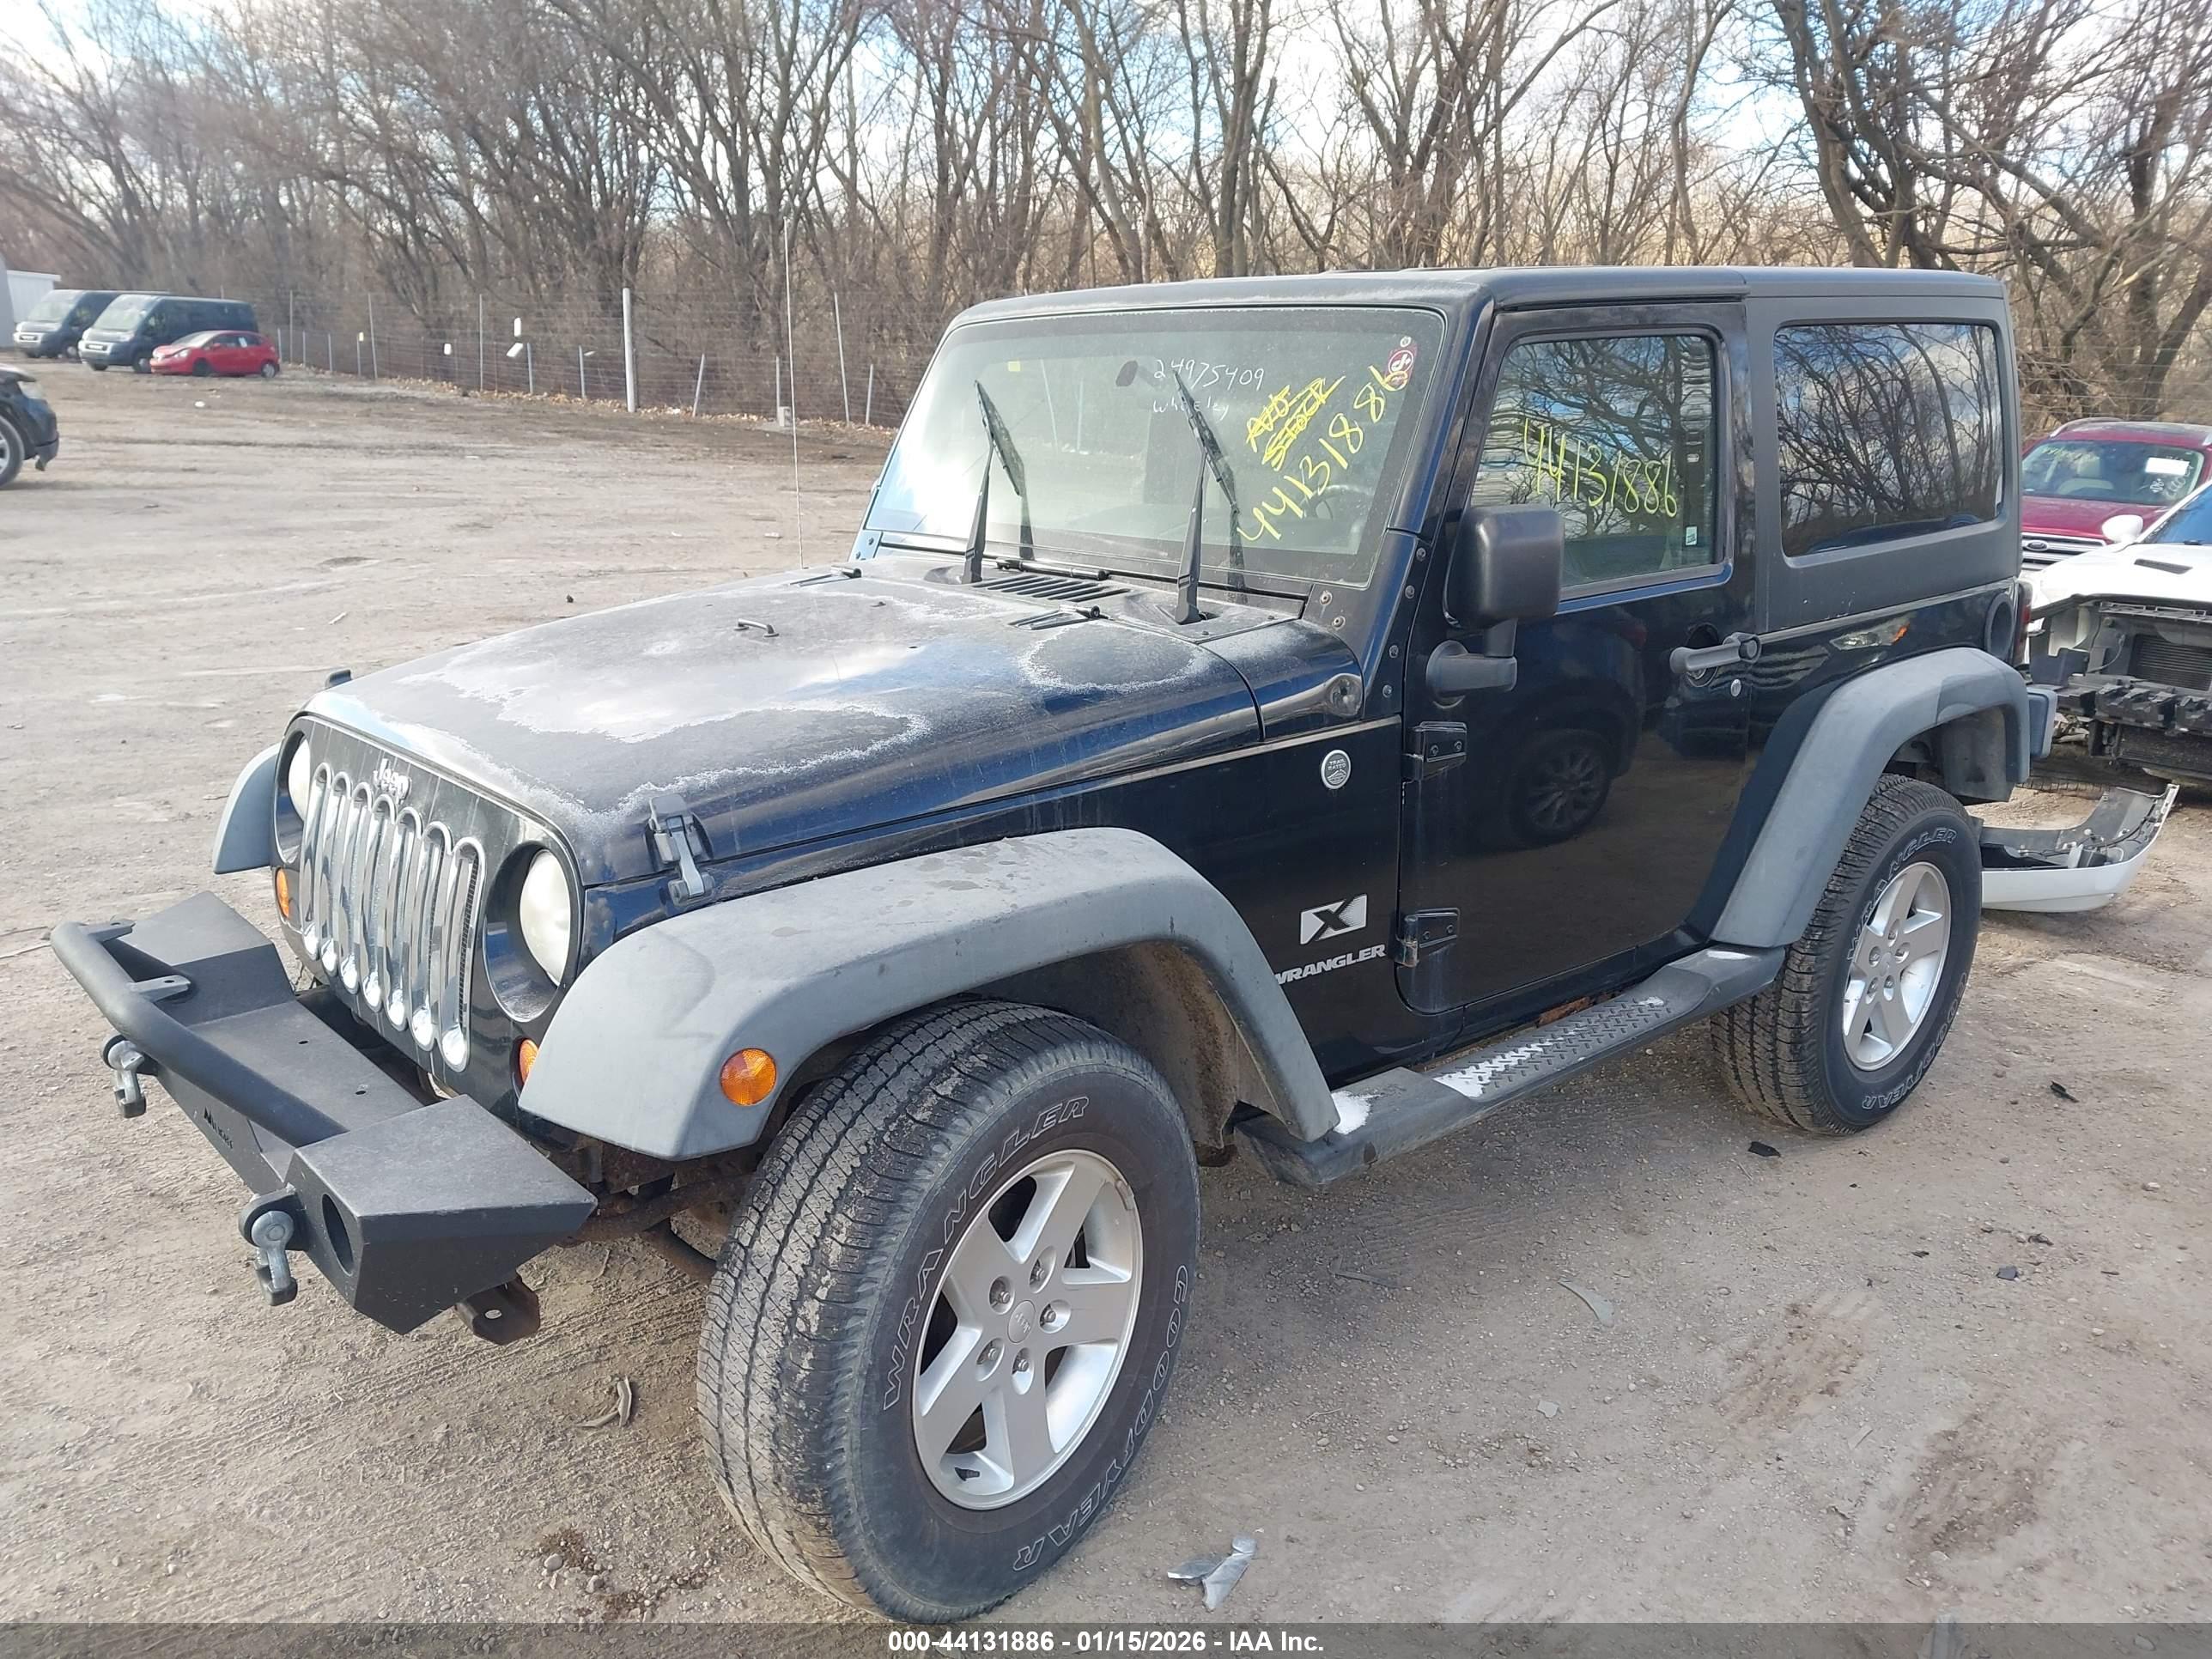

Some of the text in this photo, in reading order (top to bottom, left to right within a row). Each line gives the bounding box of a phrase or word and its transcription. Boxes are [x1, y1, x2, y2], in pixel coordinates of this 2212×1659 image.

[1237, 365, 1408, 543] 44131886
[1523, 417, 1677, 518] 44131886
[883, 1095, 1091, 1412] WRANGLER
[1012, 1263, 1189, 1573] GOODYEAR
